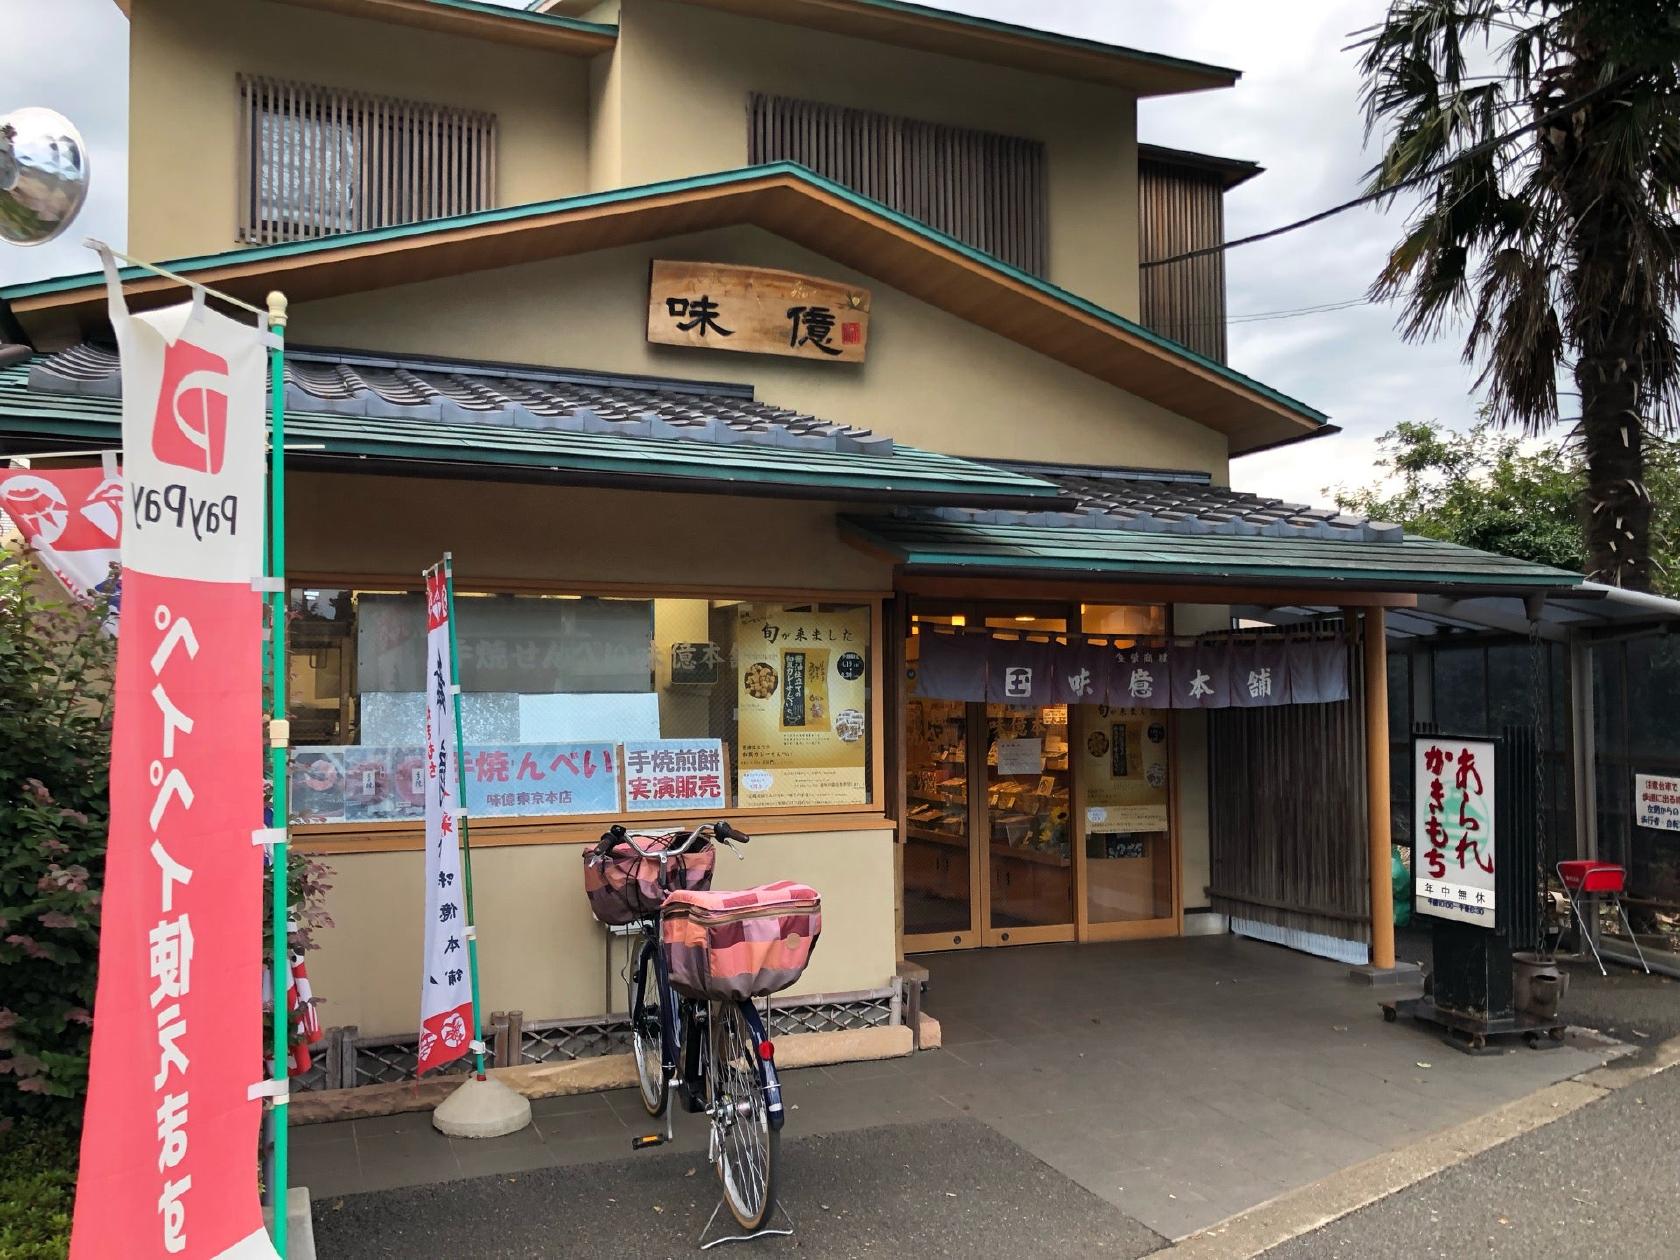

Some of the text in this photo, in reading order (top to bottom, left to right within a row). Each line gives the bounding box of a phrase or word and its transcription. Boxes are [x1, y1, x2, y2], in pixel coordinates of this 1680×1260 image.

[665, 294, 843, 356] 味億
[761, 622, 853, 644] 旬が来ました
[1067, 666, 1273, 699] 味億本舗
[627, 748, 720, 774] 手焼煎餅
[486, 790, 572, 808] 味億東京本店
[628, 775, 721, 801] 実演販売
[1423, 745, 1454, 879] かきもち
[1455, 747, 1494, 874] あられ
[1424, 882, 1486, 905] 年中無休
